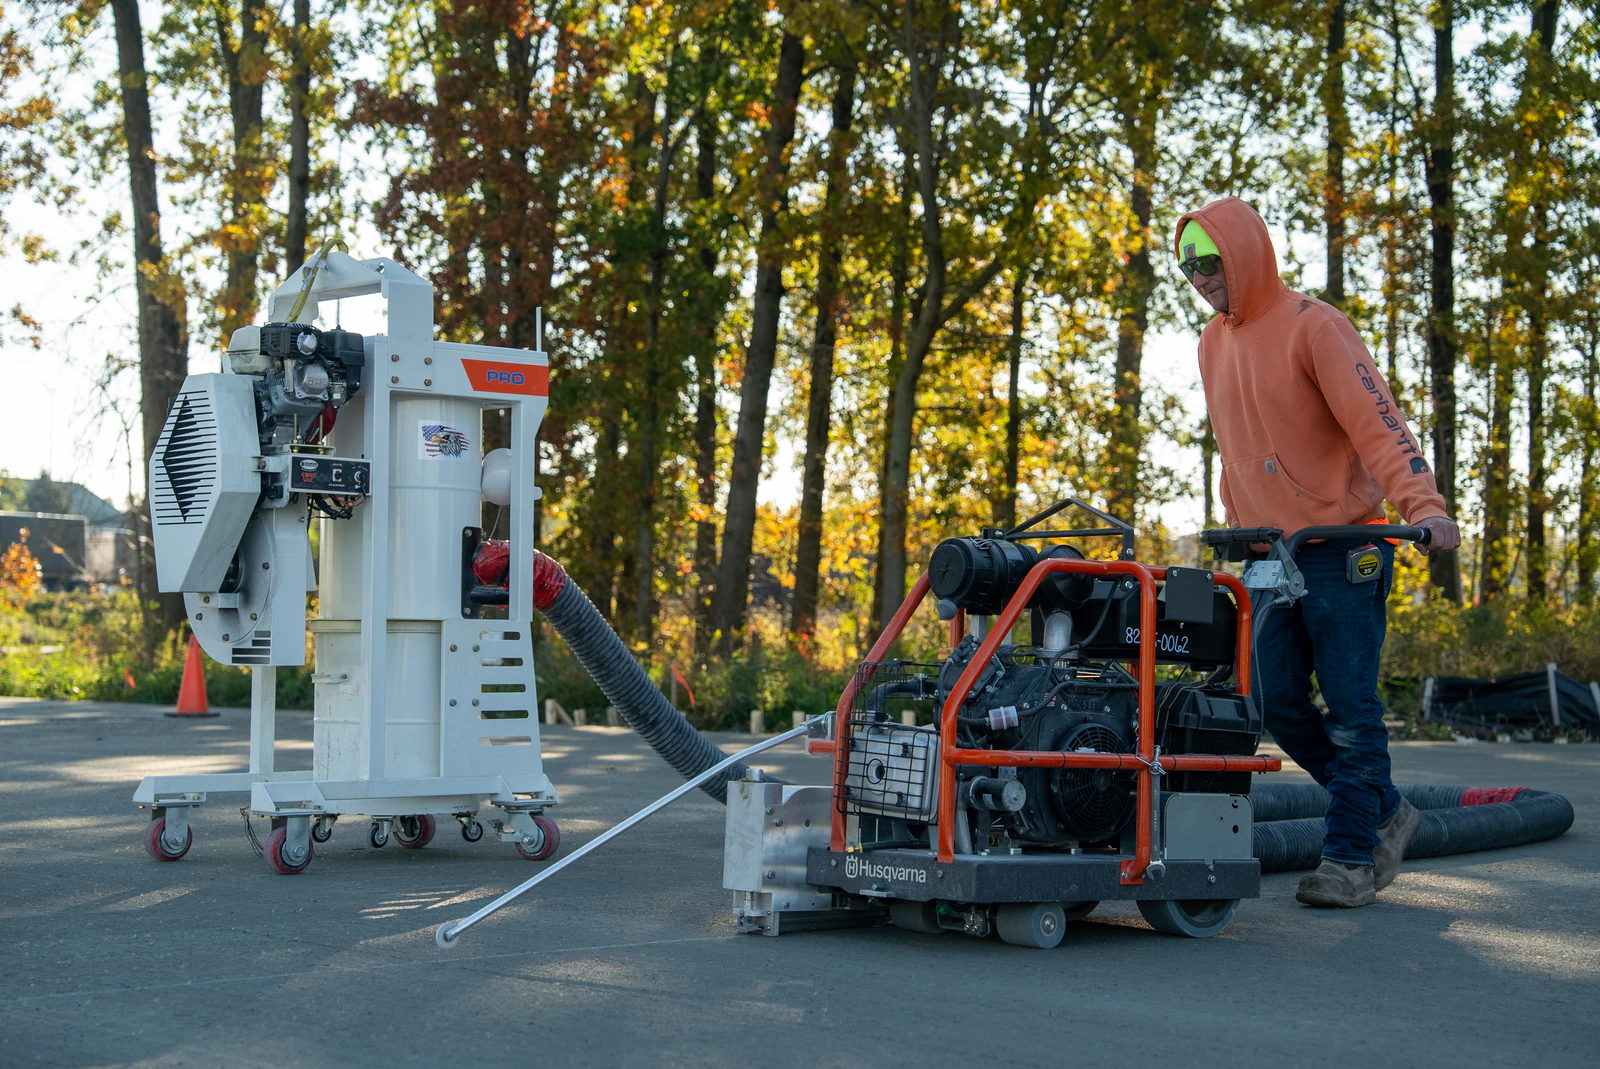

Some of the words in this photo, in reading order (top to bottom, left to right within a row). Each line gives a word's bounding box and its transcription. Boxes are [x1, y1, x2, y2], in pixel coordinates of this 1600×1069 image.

[487, 370, 525, 385] PRO
[1355, 363, 1417, 455] carhartt
[859, 859, 927, 883] Husqvarna
